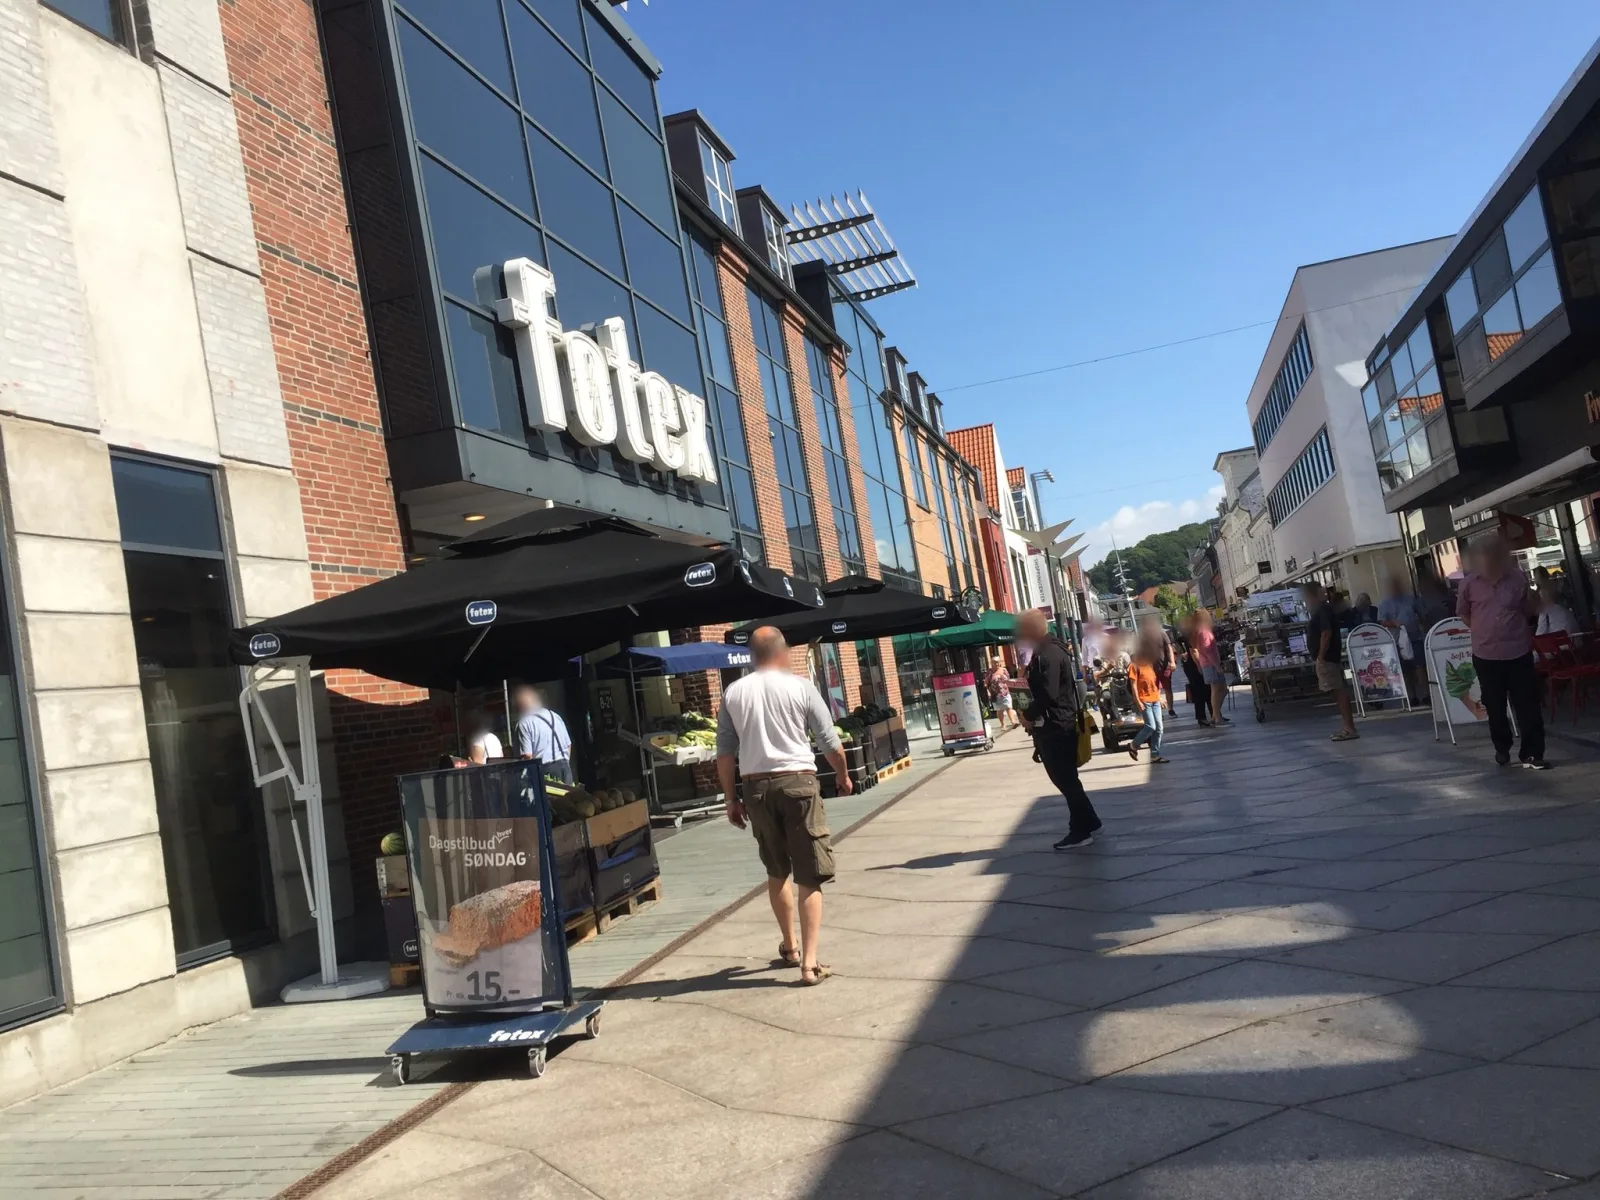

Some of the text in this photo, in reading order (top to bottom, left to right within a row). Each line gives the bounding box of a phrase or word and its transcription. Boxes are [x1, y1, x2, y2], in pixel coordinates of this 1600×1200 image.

[428, 827, 513, 853] Dagstilbud hver
[464, 851, 527, 867] SØNDAG
